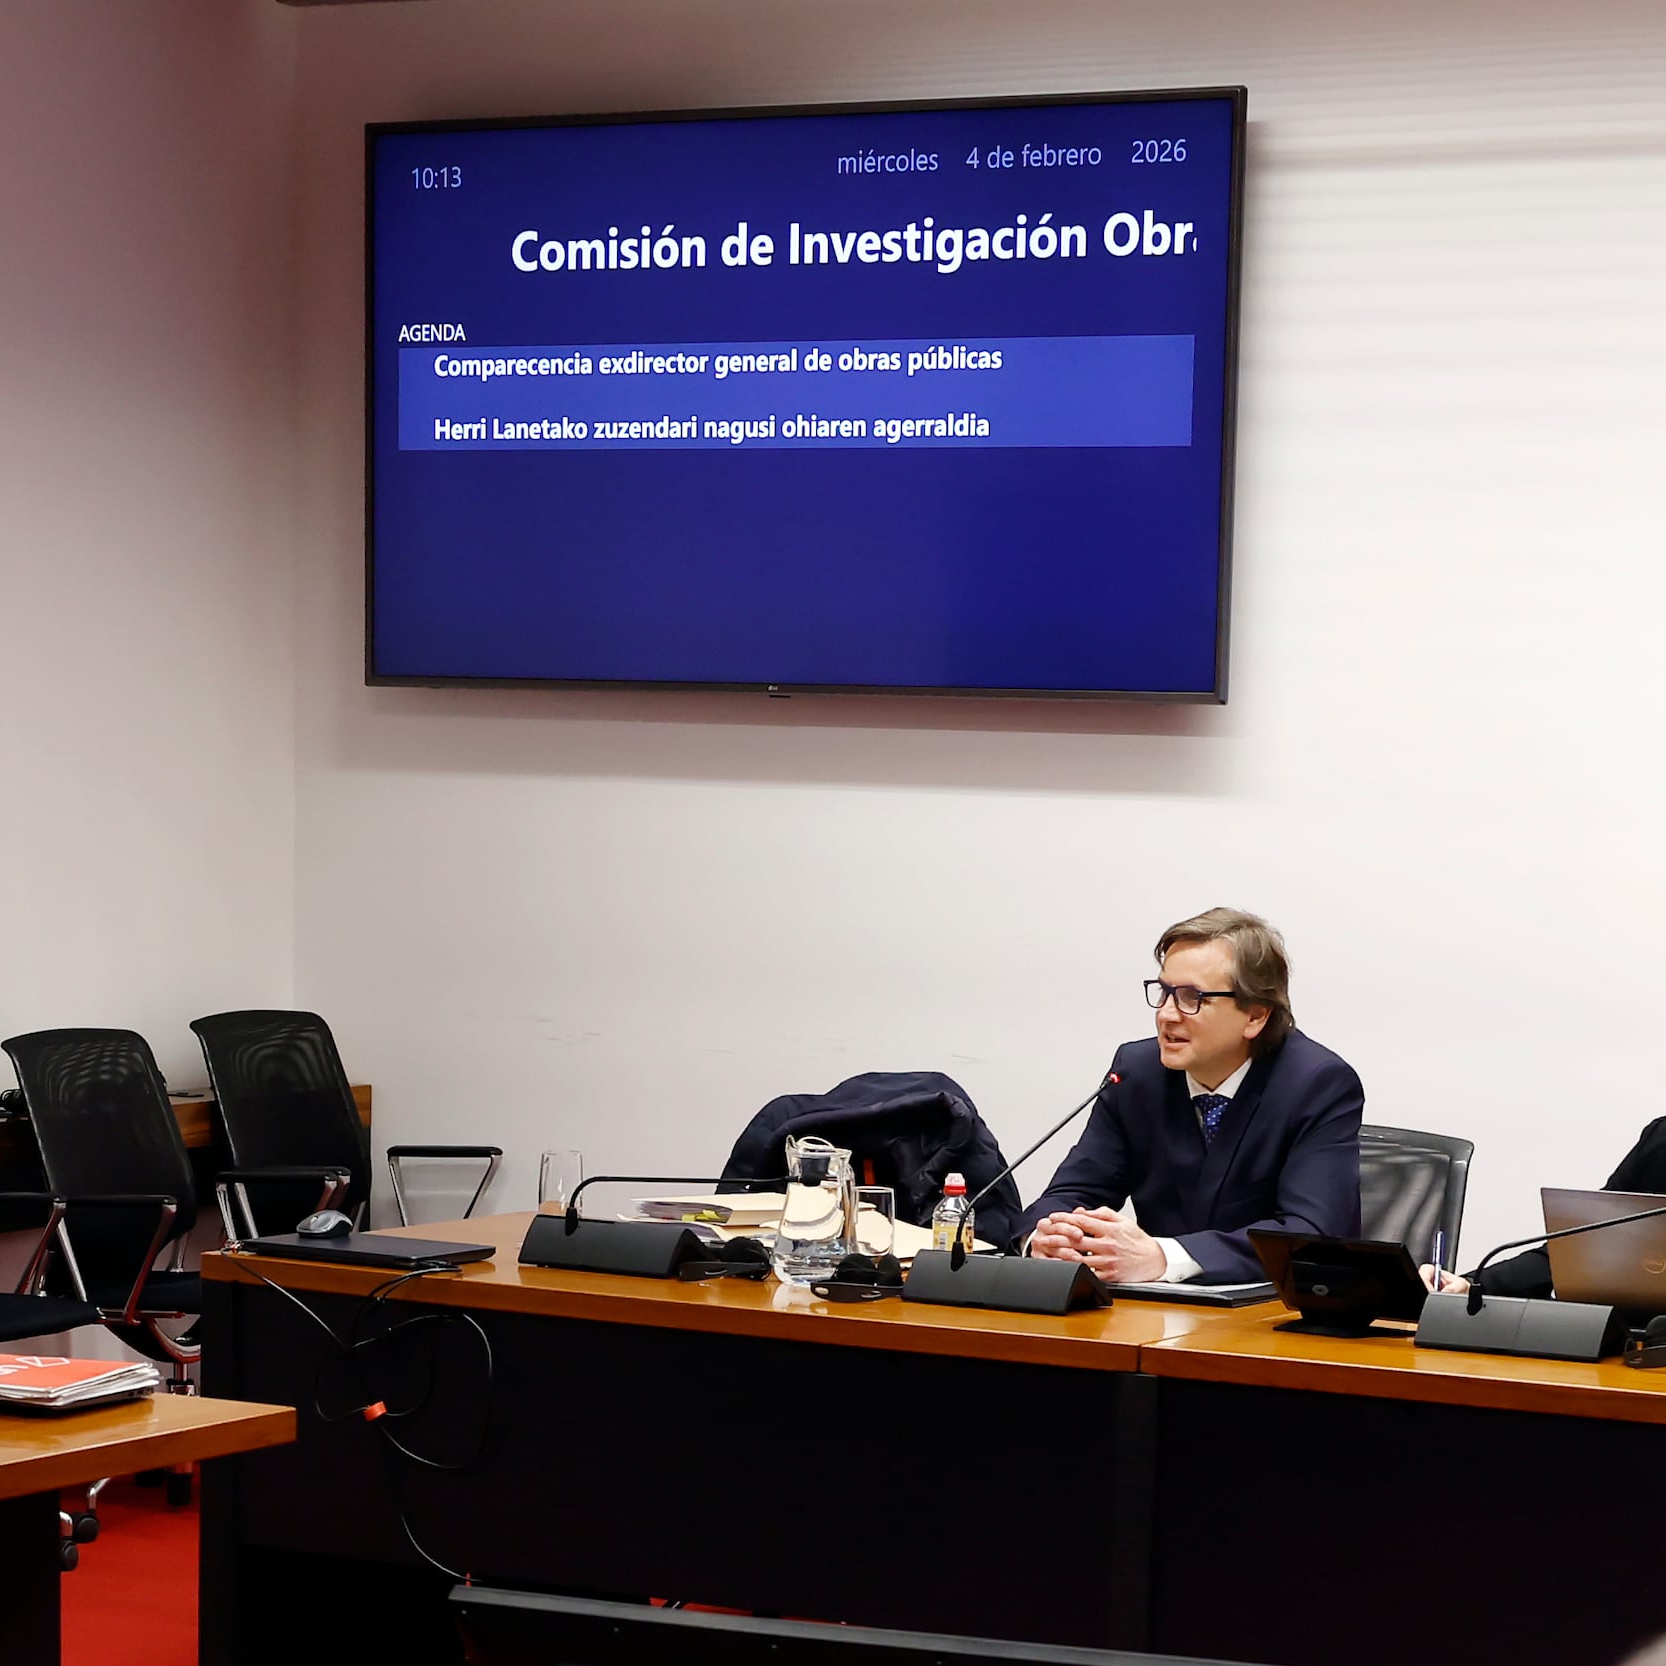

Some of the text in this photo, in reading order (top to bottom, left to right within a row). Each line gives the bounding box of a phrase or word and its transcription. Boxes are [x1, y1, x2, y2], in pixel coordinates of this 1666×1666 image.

[837, 138, 1187, 174] miércoles 4 de febrero 2026
[411, 166, 462, 189] 10:13
[511, 209, 1198, 274] Comisión de Investigación Obr
[398, 323, 467, 343] AGENDA
[434, 345, 1003, 382] Comparecencia exdirector general de obras públicas
[434, 412, 990, 445] Herri Lanetako zuzendari nagusi ohiaren agerraldia
